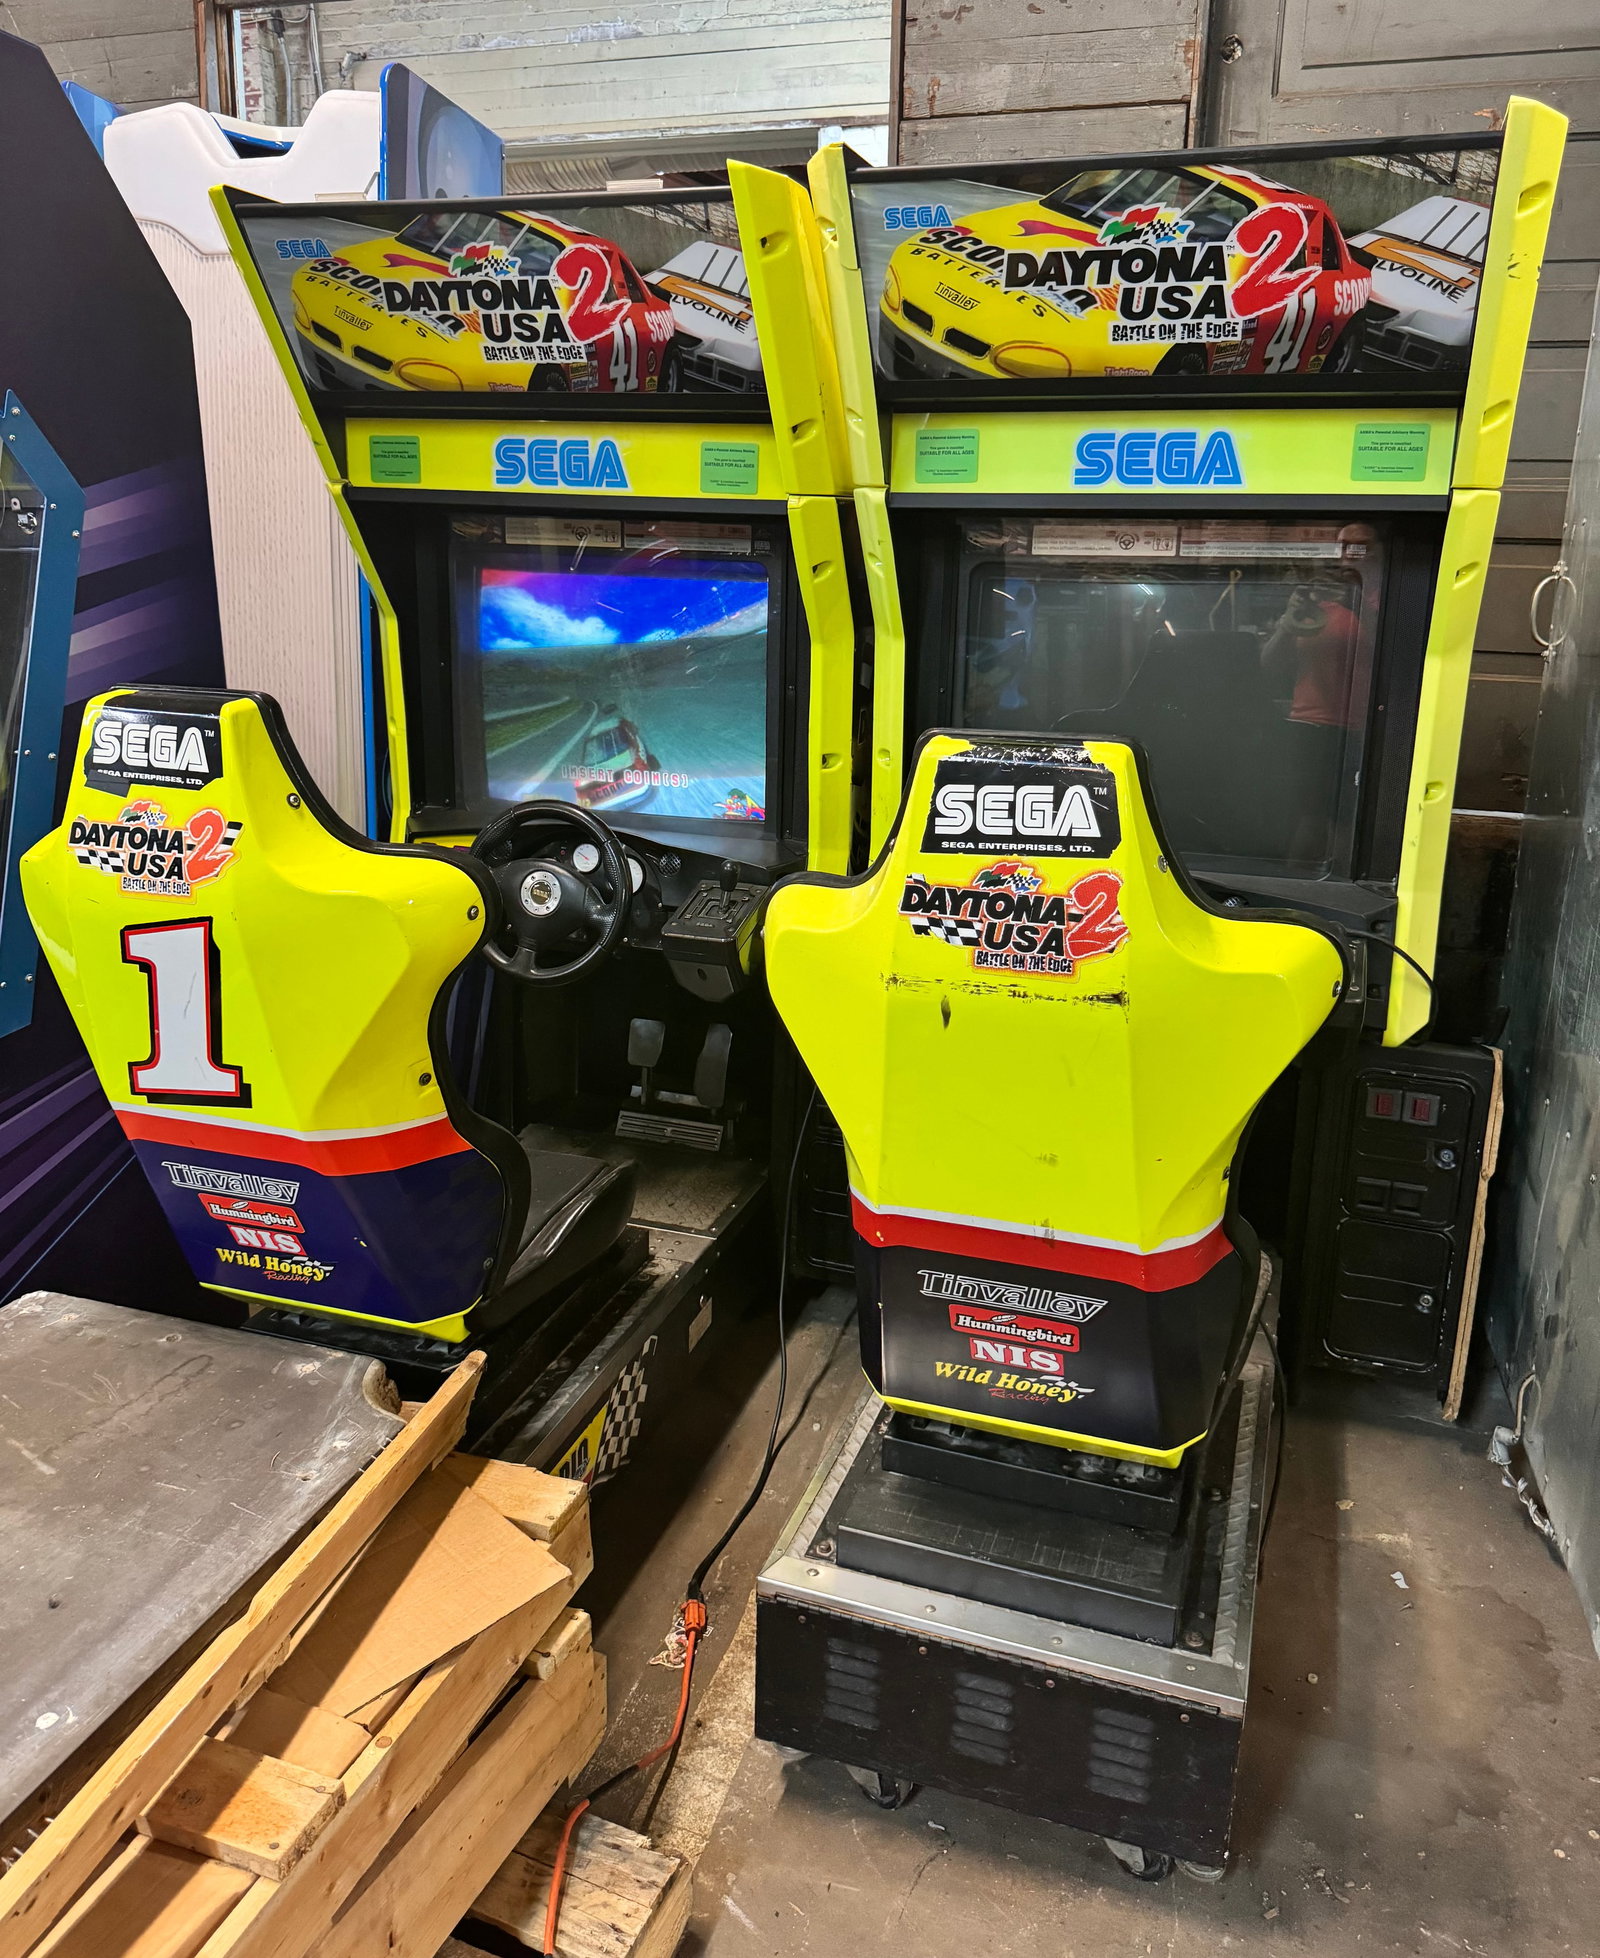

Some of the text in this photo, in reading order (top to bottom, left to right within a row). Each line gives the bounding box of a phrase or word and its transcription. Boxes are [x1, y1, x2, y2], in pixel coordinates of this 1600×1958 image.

[884, 205, 952, 229] SEGA
[275, 238, 332, 259] SEGA
[1233, 203, 1321, 317] 2
[1005, 245, 1226, 288] DAYTONA
[1376, 259, 1466, 304] LVOLINE
[383, 279, 559, 312] DAYTONA
[554, 244, 632, 342] 2
[934, 281, 981, 311] Tinvalley
[1119, 284, 1227, 321] USA
[333, 304, 374, 332] Tinvalley
[482, 313, 570, 343] USA
[671, 295, 749, 334] LVOLINE
[1112, 323, 1155, 342] BATTLE
[1158, 323, 1176, 341] ON
[1181, 322, 1203, 340] THE
[1206, 321, 1240, 339] EDGE
[1264, 287, 1316, 374] 41
[483, 345, 521, 361] BATTLE
[522, 346, 535, 361] ON
[538, 346, 556, 361] THE
[557, 345, 585, 360] EDGE
[609, 317, 639, 392] 41
[494, 438, 629, 488] SEGA
[1074, 431, 1243, 485] SEGA
[92, 720, 210, 773] SEGA
[123, 772, 185, 784] ENTERPRISES,
[186, 777, 205, 786] LTD.
[561, 764, 689, 788] INSERT COIN(S)
[934, 784, 1102, 838] SEGA
[68, 822, 184, 855] DAYTONA
[186, 809, 234, 882] 2
[941, 841, 1095, 853] SEGA ENTERPRISES, LTD.
[127, 852, 184, 881] USA
[122, 877, 191, 895] BATTLE ON THE EDGE
[900, 884, 1067, 926] DAYTONA
[1067, 873, 1129, 957] 2
[984, 922, 1065, 957] USA
[976, 950, 1073, 973] BATTLE ON THE EDGE
[120, 916, 253, 1109] 1
[161, 1161, 300, 1205] Tinvalley
[209, 1202, 297, 1228] Hummingbird
[230, 1226, 302, 1254] NIS
[215, 1247, 326, 1282] Wild Honey
[916, 1269, 1109, 1323] Tinvalley
[957, 1314, 1073, 1346] Hummingbird
[972, 1339, 1061, 1372] NIS
[935, 1361, 1078, 1403] Wild Honey
